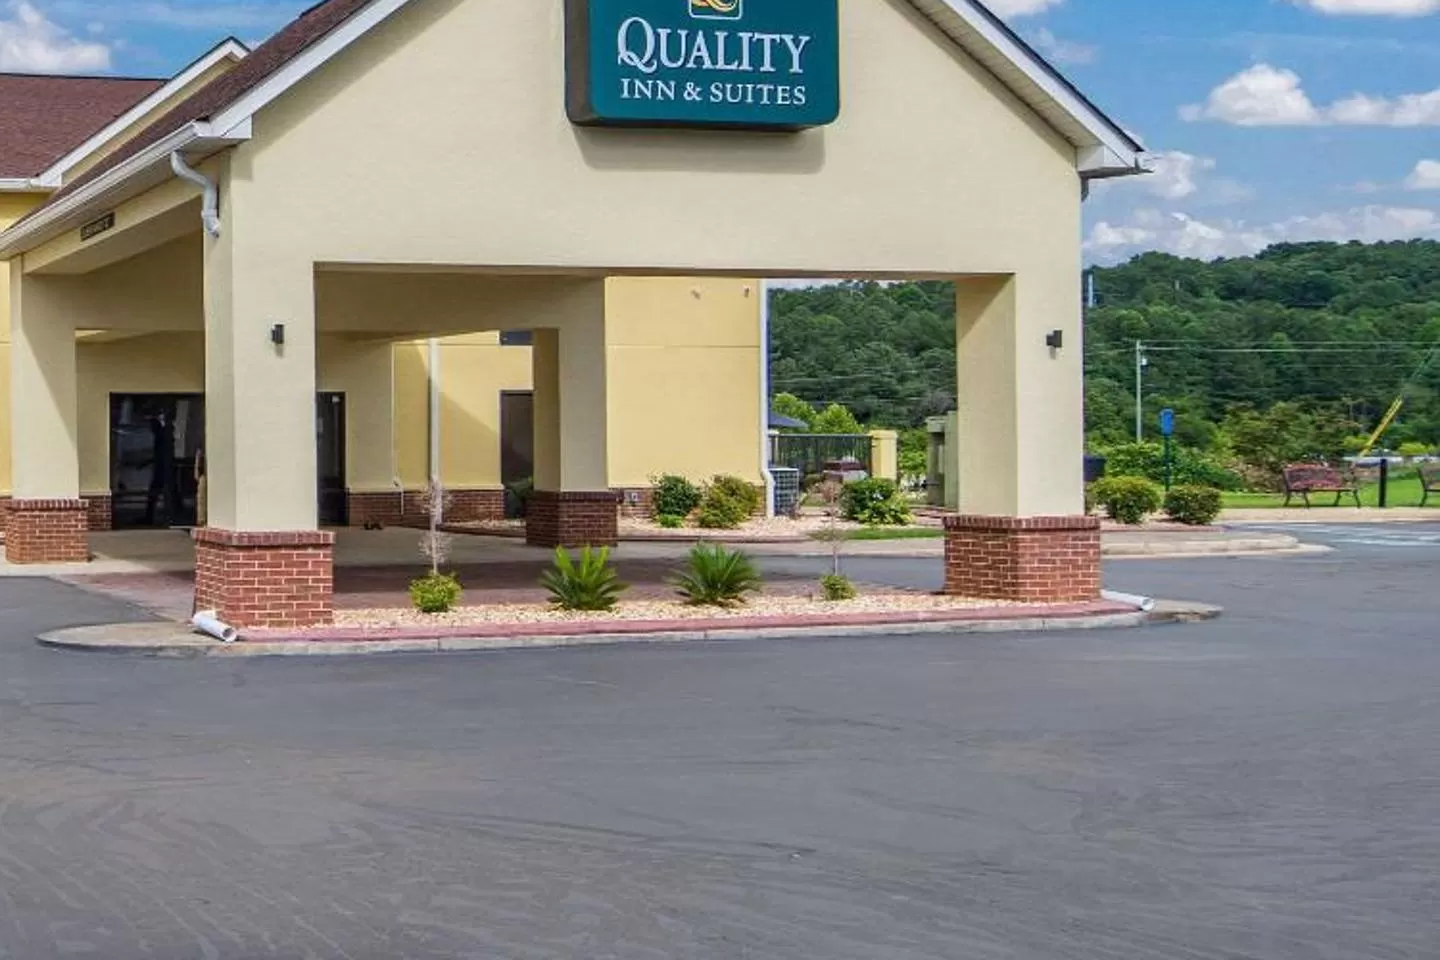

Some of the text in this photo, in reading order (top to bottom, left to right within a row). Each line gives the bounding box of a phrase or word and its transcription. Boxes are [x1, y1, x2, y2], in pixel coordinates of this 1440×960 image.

[616, 16, 810, 74] QUALITY
[620, 78, 807, 106] INN & SUITES
